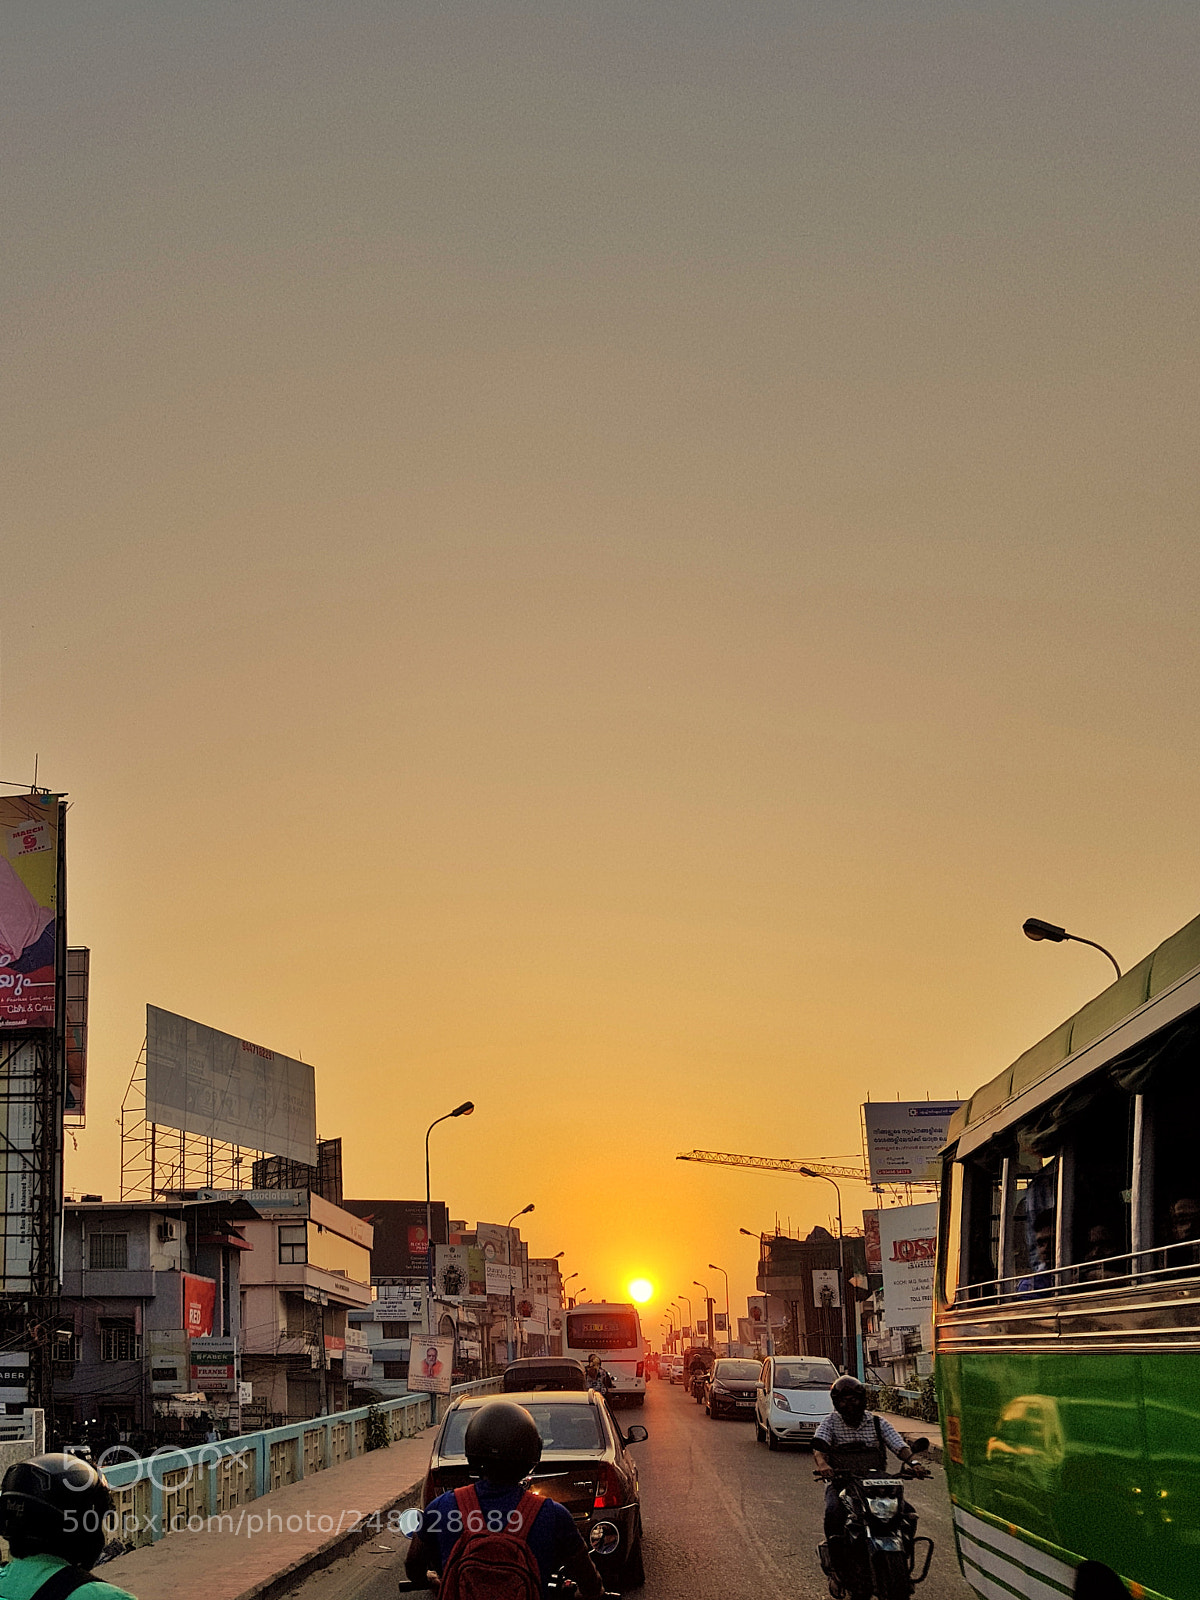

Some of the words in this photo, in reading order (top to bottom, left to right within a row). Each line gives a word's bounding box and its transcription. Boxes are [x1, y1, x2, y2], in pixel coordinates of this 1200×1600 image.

[12, 826, 44, 838] MARCH
[23, 835, 37, 849] 9
[190, 1308, 201, 1325] RED
